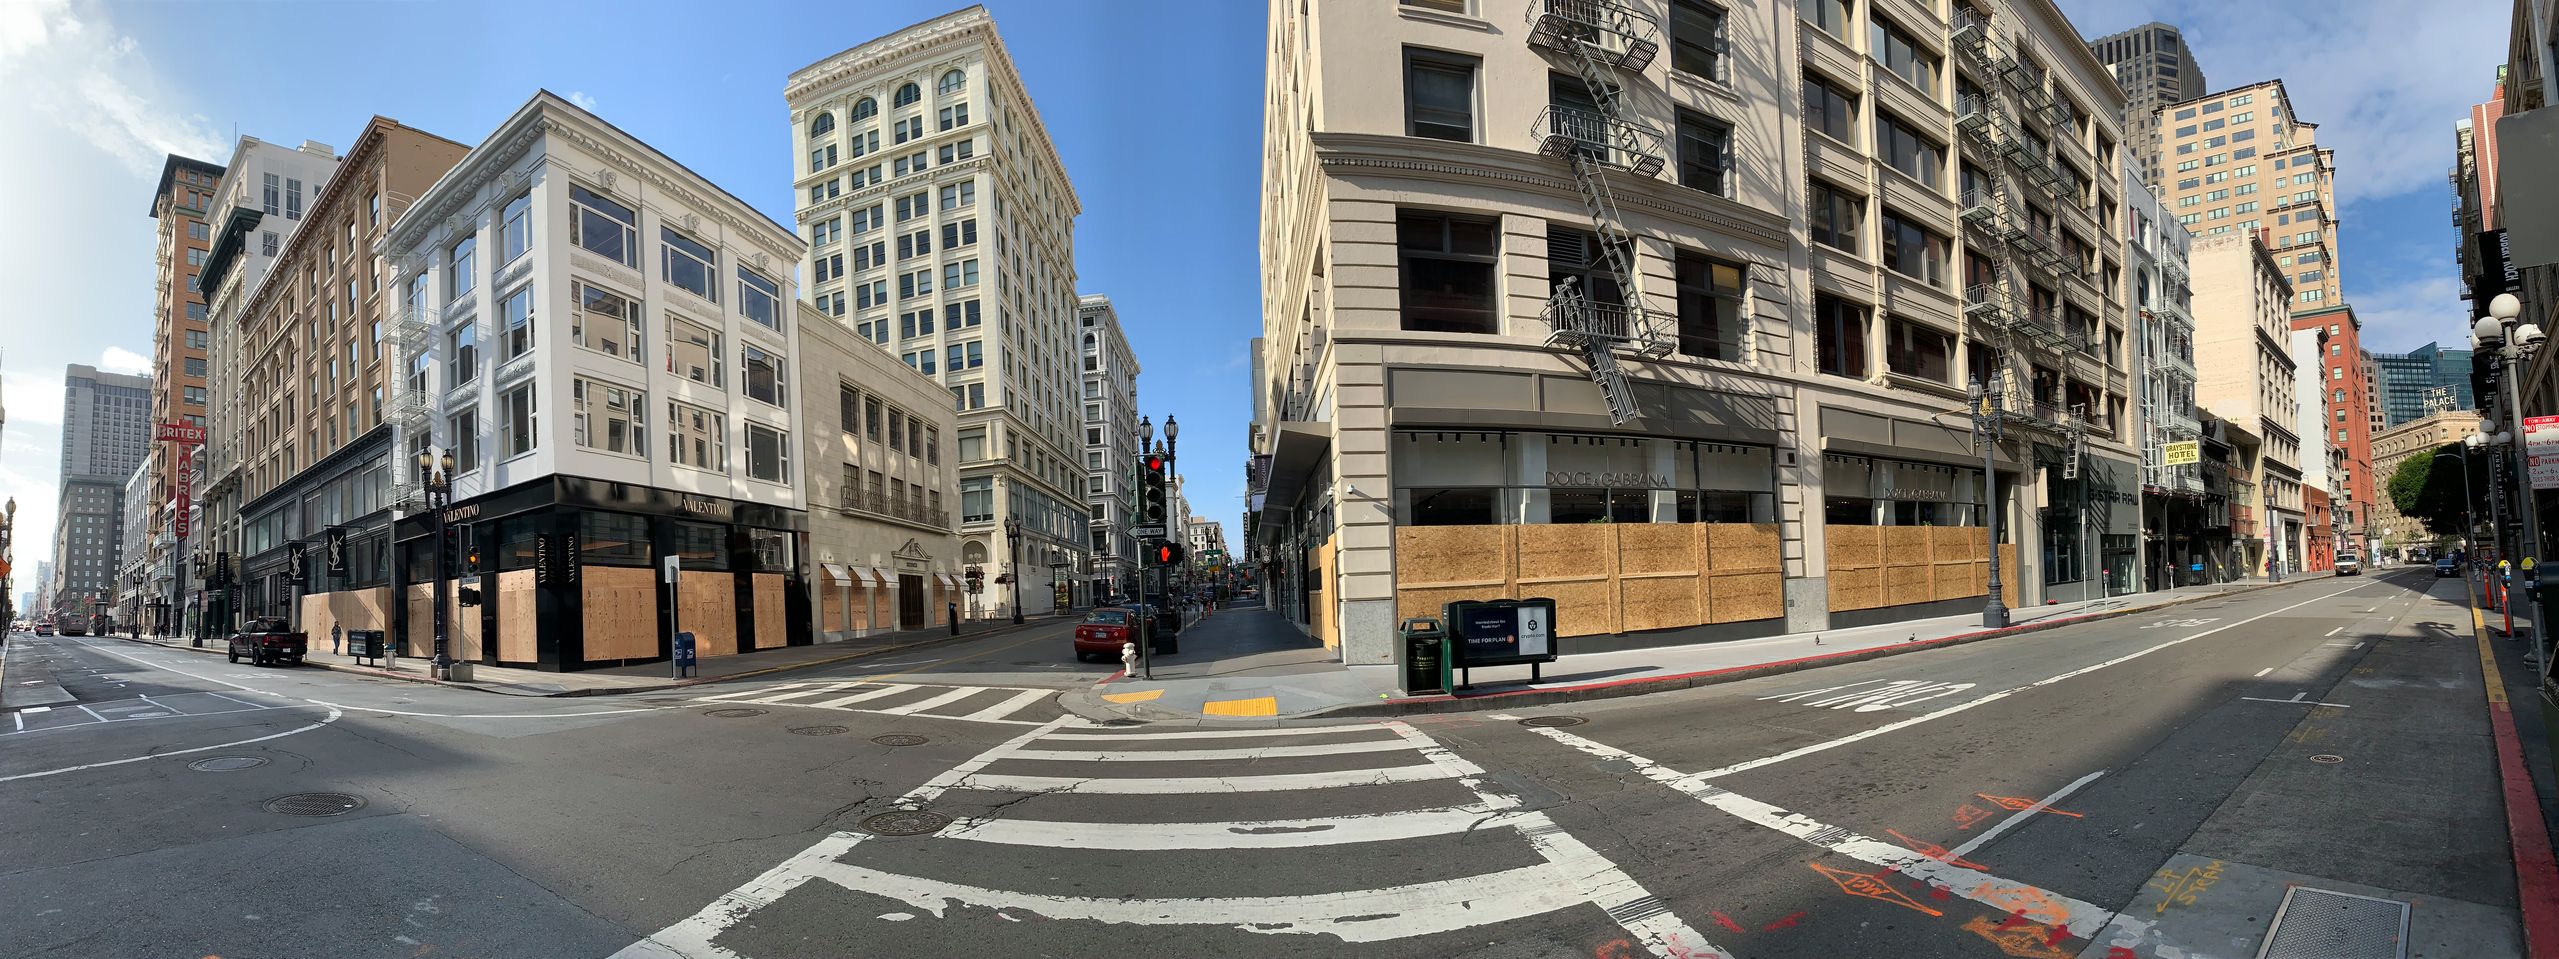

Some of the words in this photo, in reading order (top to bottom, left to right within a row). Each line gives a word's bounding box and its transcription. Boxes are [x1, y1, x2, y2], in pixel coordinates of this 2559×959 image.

[2431, 387, 2447, 397] THE
[2423, 395, 2455, 408] PALACE
[156, 425, 203, 440] BRITEX
[2525, 424, 2536, 433] NO
[2529, 456, 2540, 466] NO
[1543, 471, 1592, 486] DOLCE
[1599, 472, 1670, 488] GABBANA
[177, 445, 190, 533] FABRICS
[443, 503, 480, 524] VALENTINO
[683, 498, 727, 516] VALENTINO
[538, 537, 546, 584] VALENTINO
